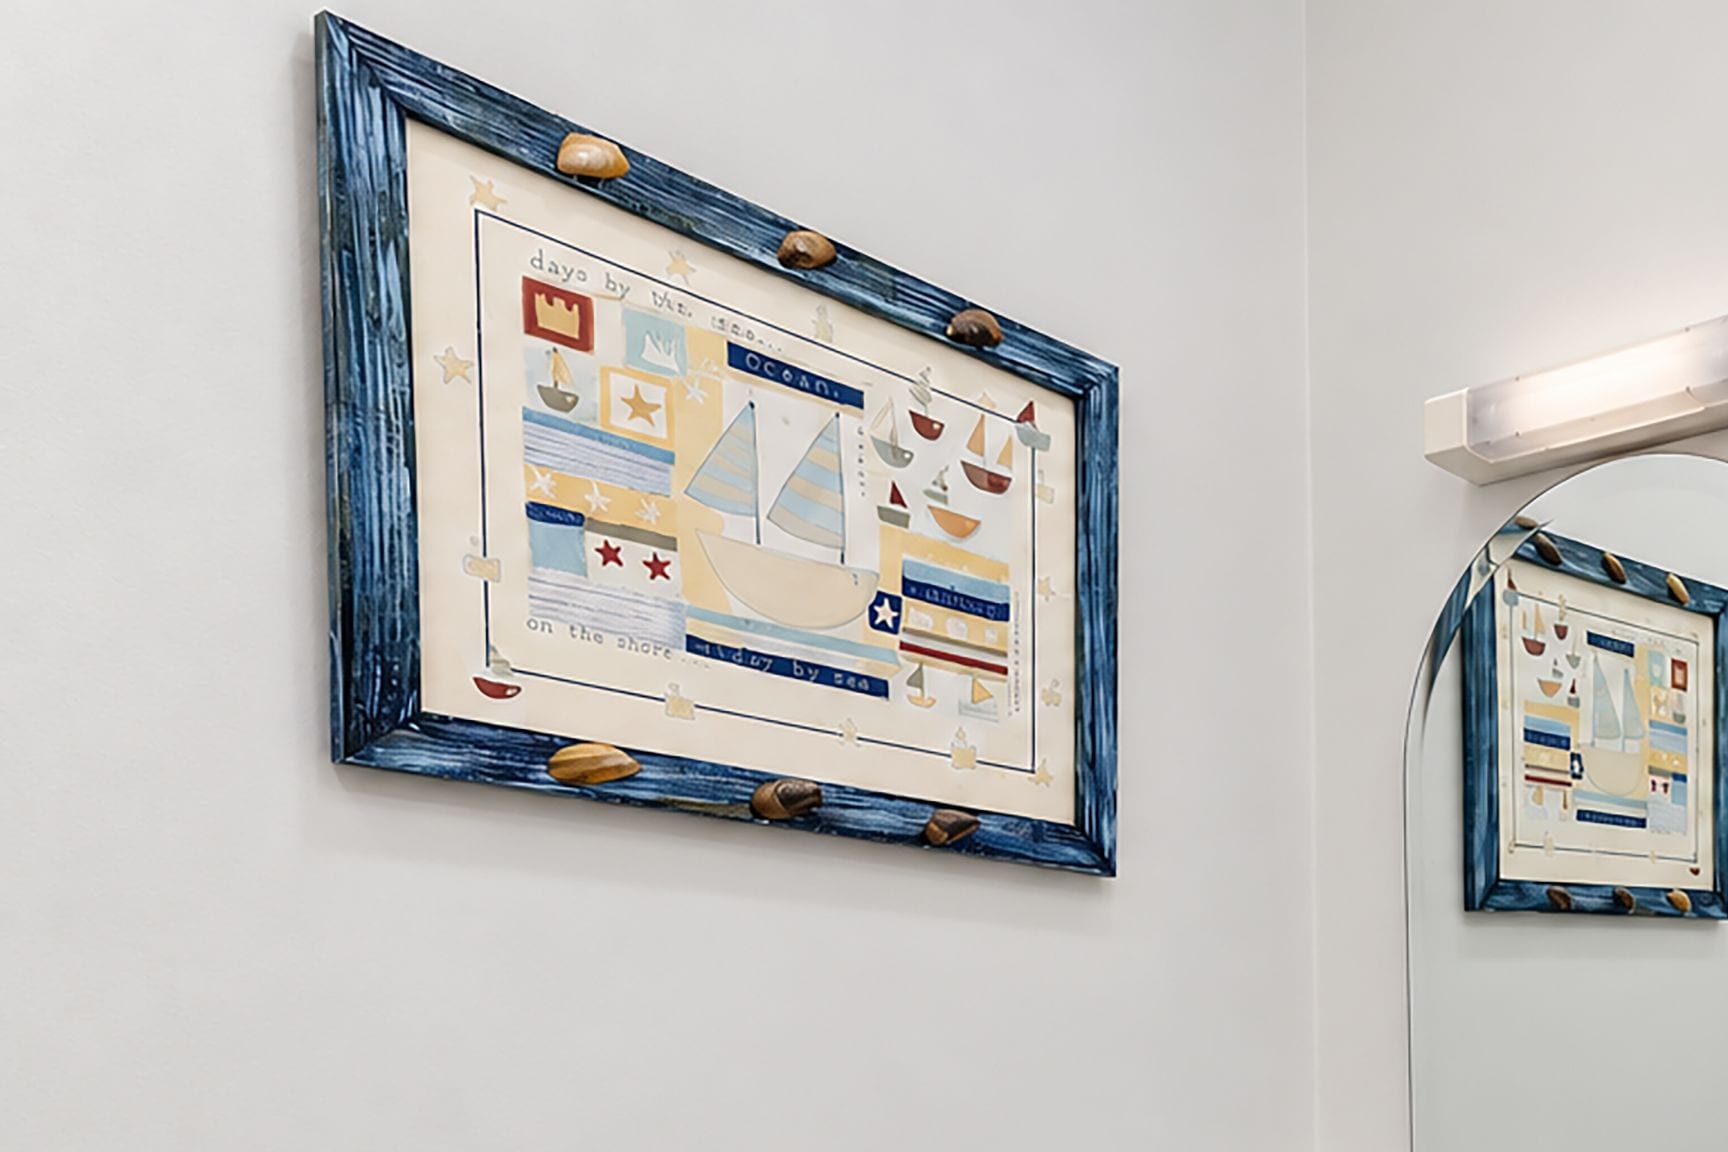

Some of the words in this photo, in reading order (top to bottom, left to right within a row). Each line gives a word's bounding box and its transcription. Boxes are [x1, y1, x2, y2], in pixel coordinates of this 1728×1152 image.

[530, 249, 588, 283] days
[604, 272, 631, 299] by
[526, 617, 553, 634] on
[569, 623, 604, 644] the
[792, 660, 820, 682] by
